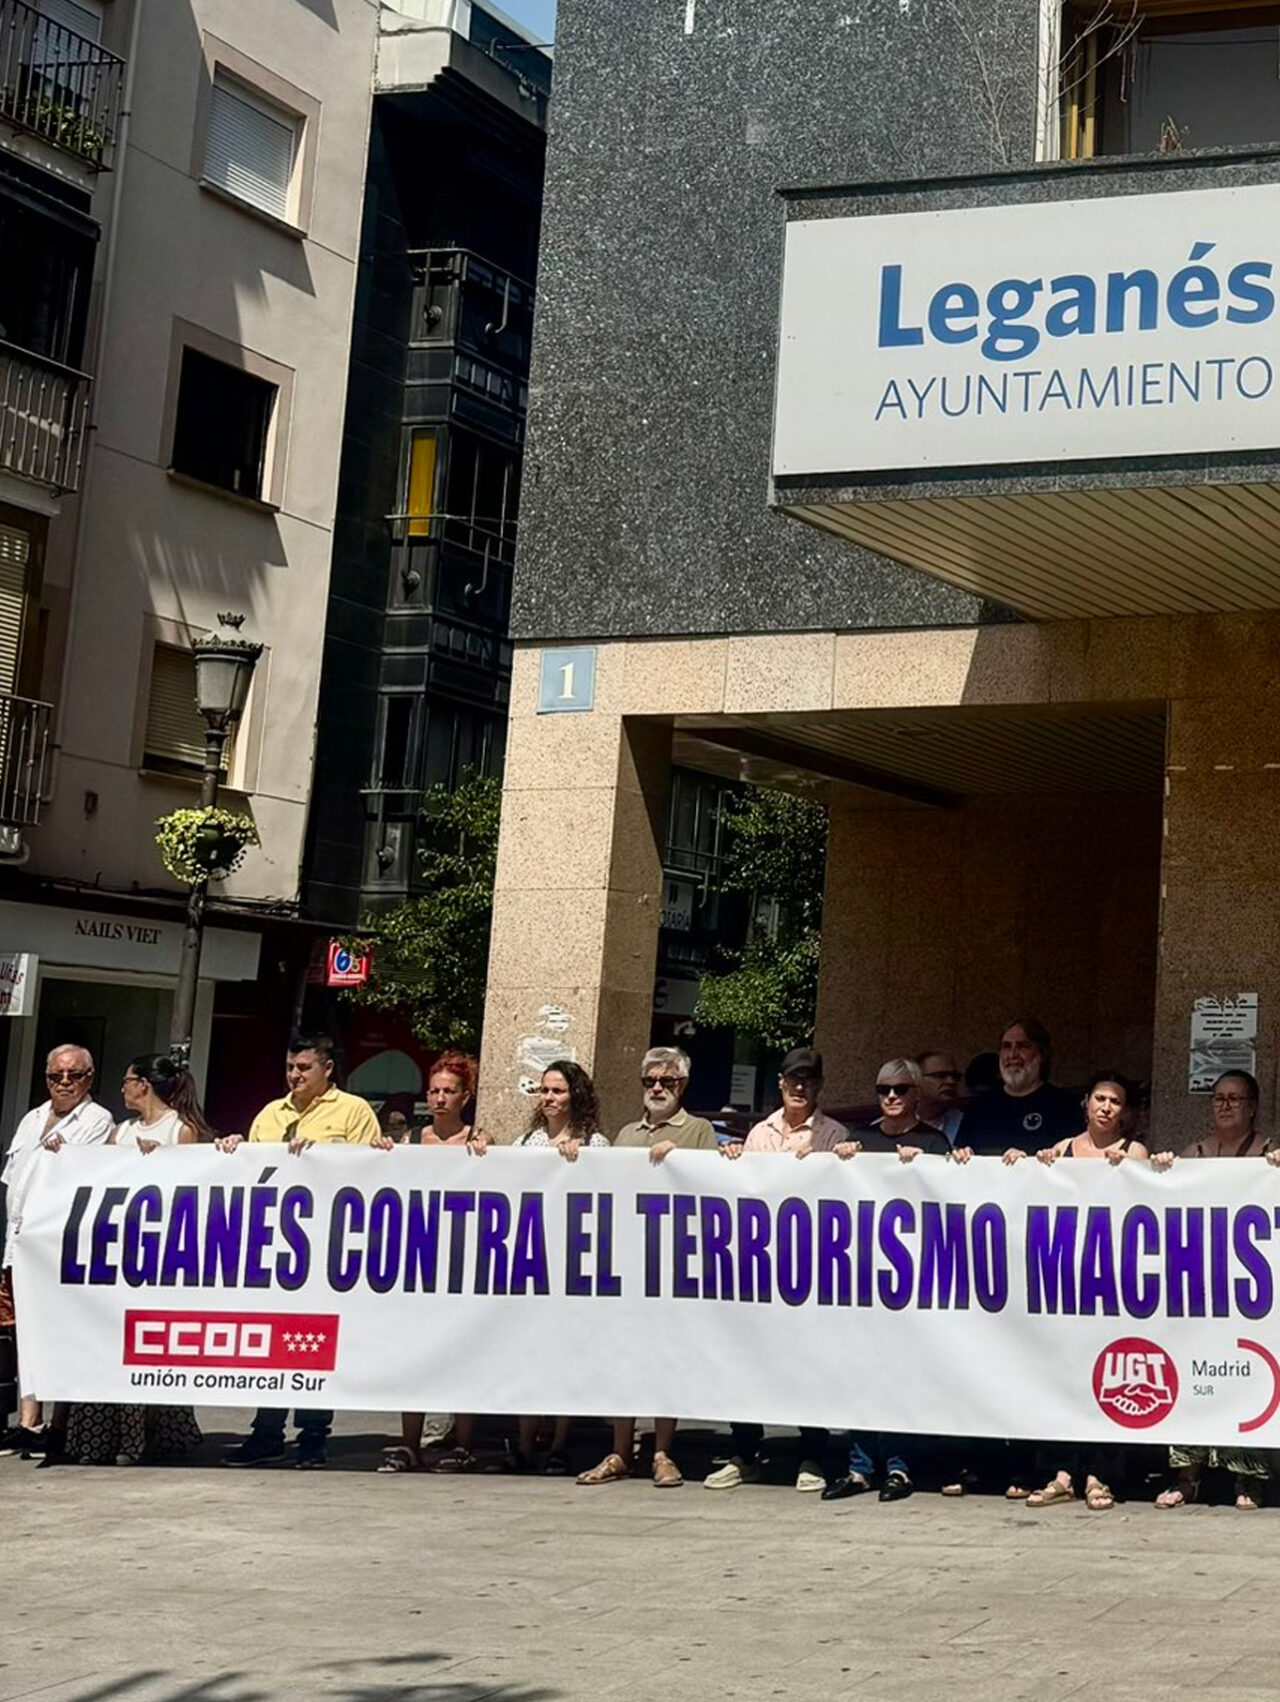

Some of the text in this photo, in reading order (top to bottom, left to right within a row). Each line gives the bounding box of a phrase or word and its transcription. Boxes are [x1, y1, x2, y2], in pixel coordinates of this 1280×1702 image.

[878, 241, 1275, 362] Leganés
[874, 355, 1273, 421] AYUNTAMIENTO
[557, 661, 576, 699] 1
[75, 919, 163, 944] NAILS VIET
[59, 1165, 314, 1293] LEGANÉS
[327, 1186, 550, 1296] CONTRA
[564, 1192, 622, 1298] EL
[636, 1192, 1009, 1315] TERRORISMO
[134, 1321, 272, 1358] CCOO
[131, 1369, 326, 1392] unión comarcal Sur
[1101, 1352, 1167, 1388] UGT
[1191, 1359, 1251, 1377] Madrid
[1192, 1385, 1214, 1396] SUR
